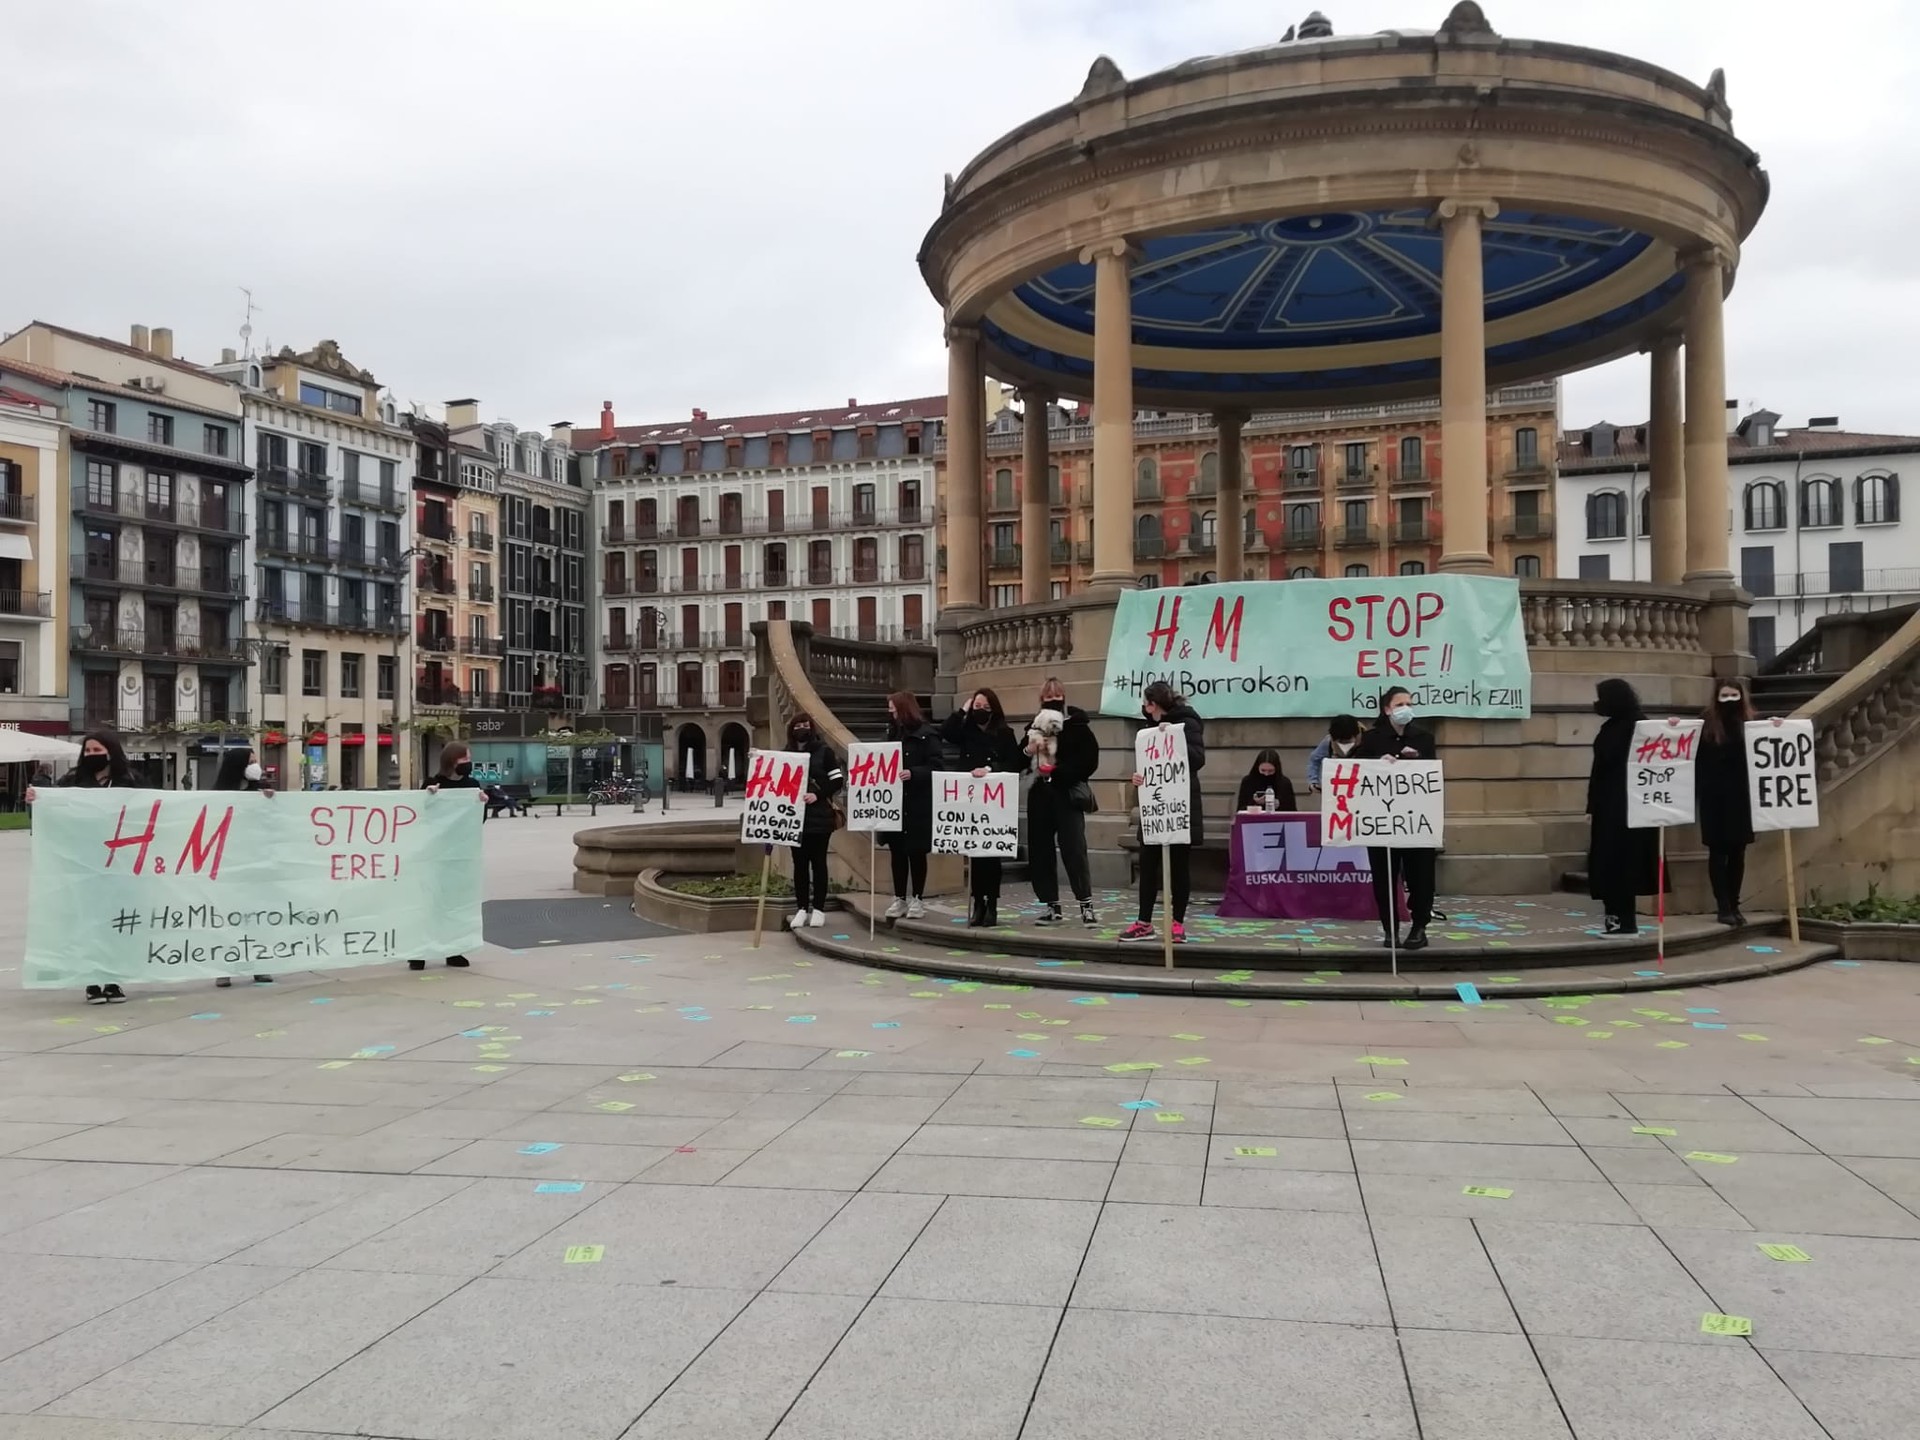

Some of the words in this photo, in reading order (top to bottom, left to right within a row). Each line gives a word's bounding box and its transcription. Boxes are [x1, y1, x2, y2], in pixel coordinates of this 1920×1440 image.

[1328, 592, 1444, 641] STOP
[477, 717, 501, 730] saba
[1636, 729, 1696, 763] H&M
[1754, 733, 1812, 769] STOP
[850, 749, 900, 787] H&M
[746, 755, 804, 804] H&M
[1330, 763, 1441, 798] HAMBRE
[1637, 768, 1675, 786] STOP
[856, 789, 892, 804] 1.100
[1152, 786, 1163, 802] €
[1642, 791, 1673, 804] ERE
[1759, 774, 1812, 807] ERE
[749, 800, 769, 812] NO
[777, 804, 796, 816] OS
[1382, 798, 1395, 812] Y
[310, 805, 417, 846] STOP
[747, 814, 801, 829] HAGAIS
[938, 811, 965, 823] CON
[971, 812, 989, 824] LA
[746, 828, 771, 838] LOS
[936, 825, 979, 835] VENTA
[933, 839, 958, 848] ESTO
[964, 840, 977, 850] ES
[330, 854, 400, 881] ERE!
[1246, 874, 1293, 885] EUSKAL
[1297, 872, 1373, 883] SINDIKATUA
[343, 929, 396, 957] EZ!!
